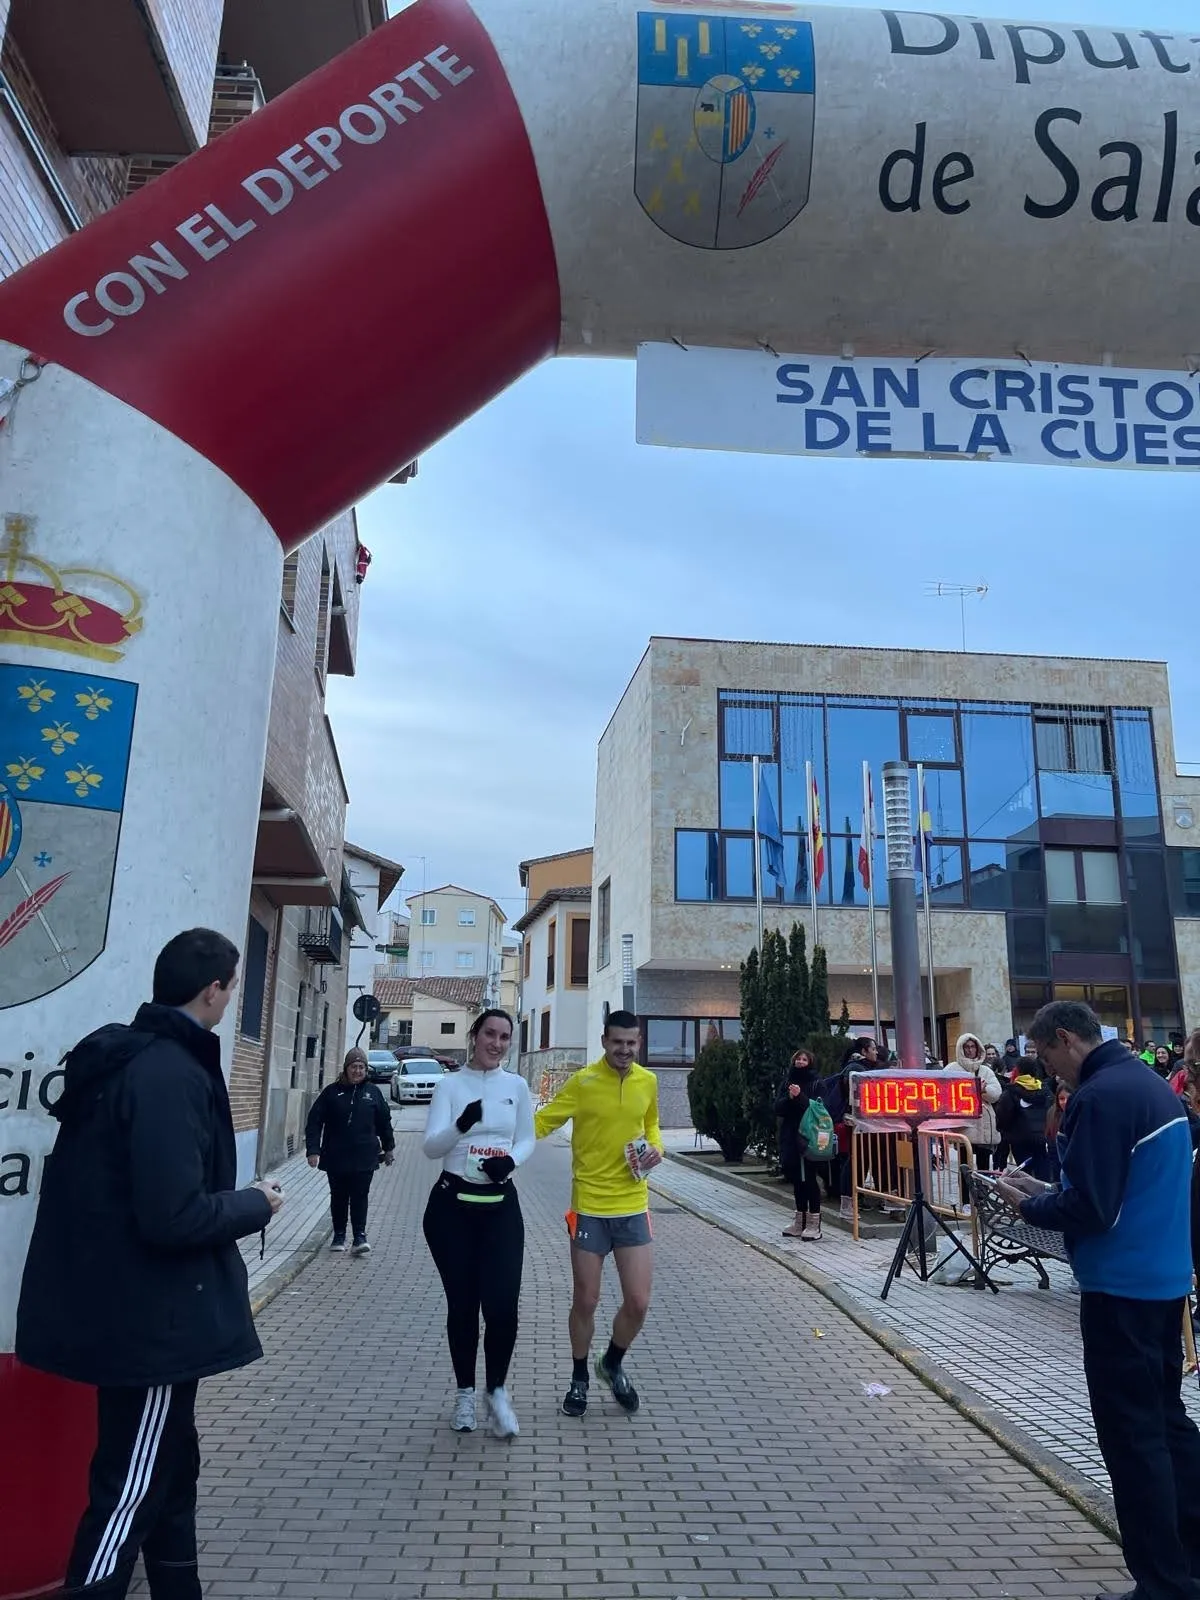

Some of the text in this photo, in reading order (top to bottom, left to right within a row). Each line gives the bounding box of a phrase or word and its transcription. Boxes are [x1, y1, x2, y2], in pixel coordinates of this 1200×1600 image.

[879, 9, 1200, 84] Diput
[63, 44, 474, 337] CON EL DEPORTE
[878, 121, 975, 215] de
[776, 363, 1200, 421] SAN CRISTO
[804, 408, 891, 451] DE
[923, 412, 1012, 456] LA
